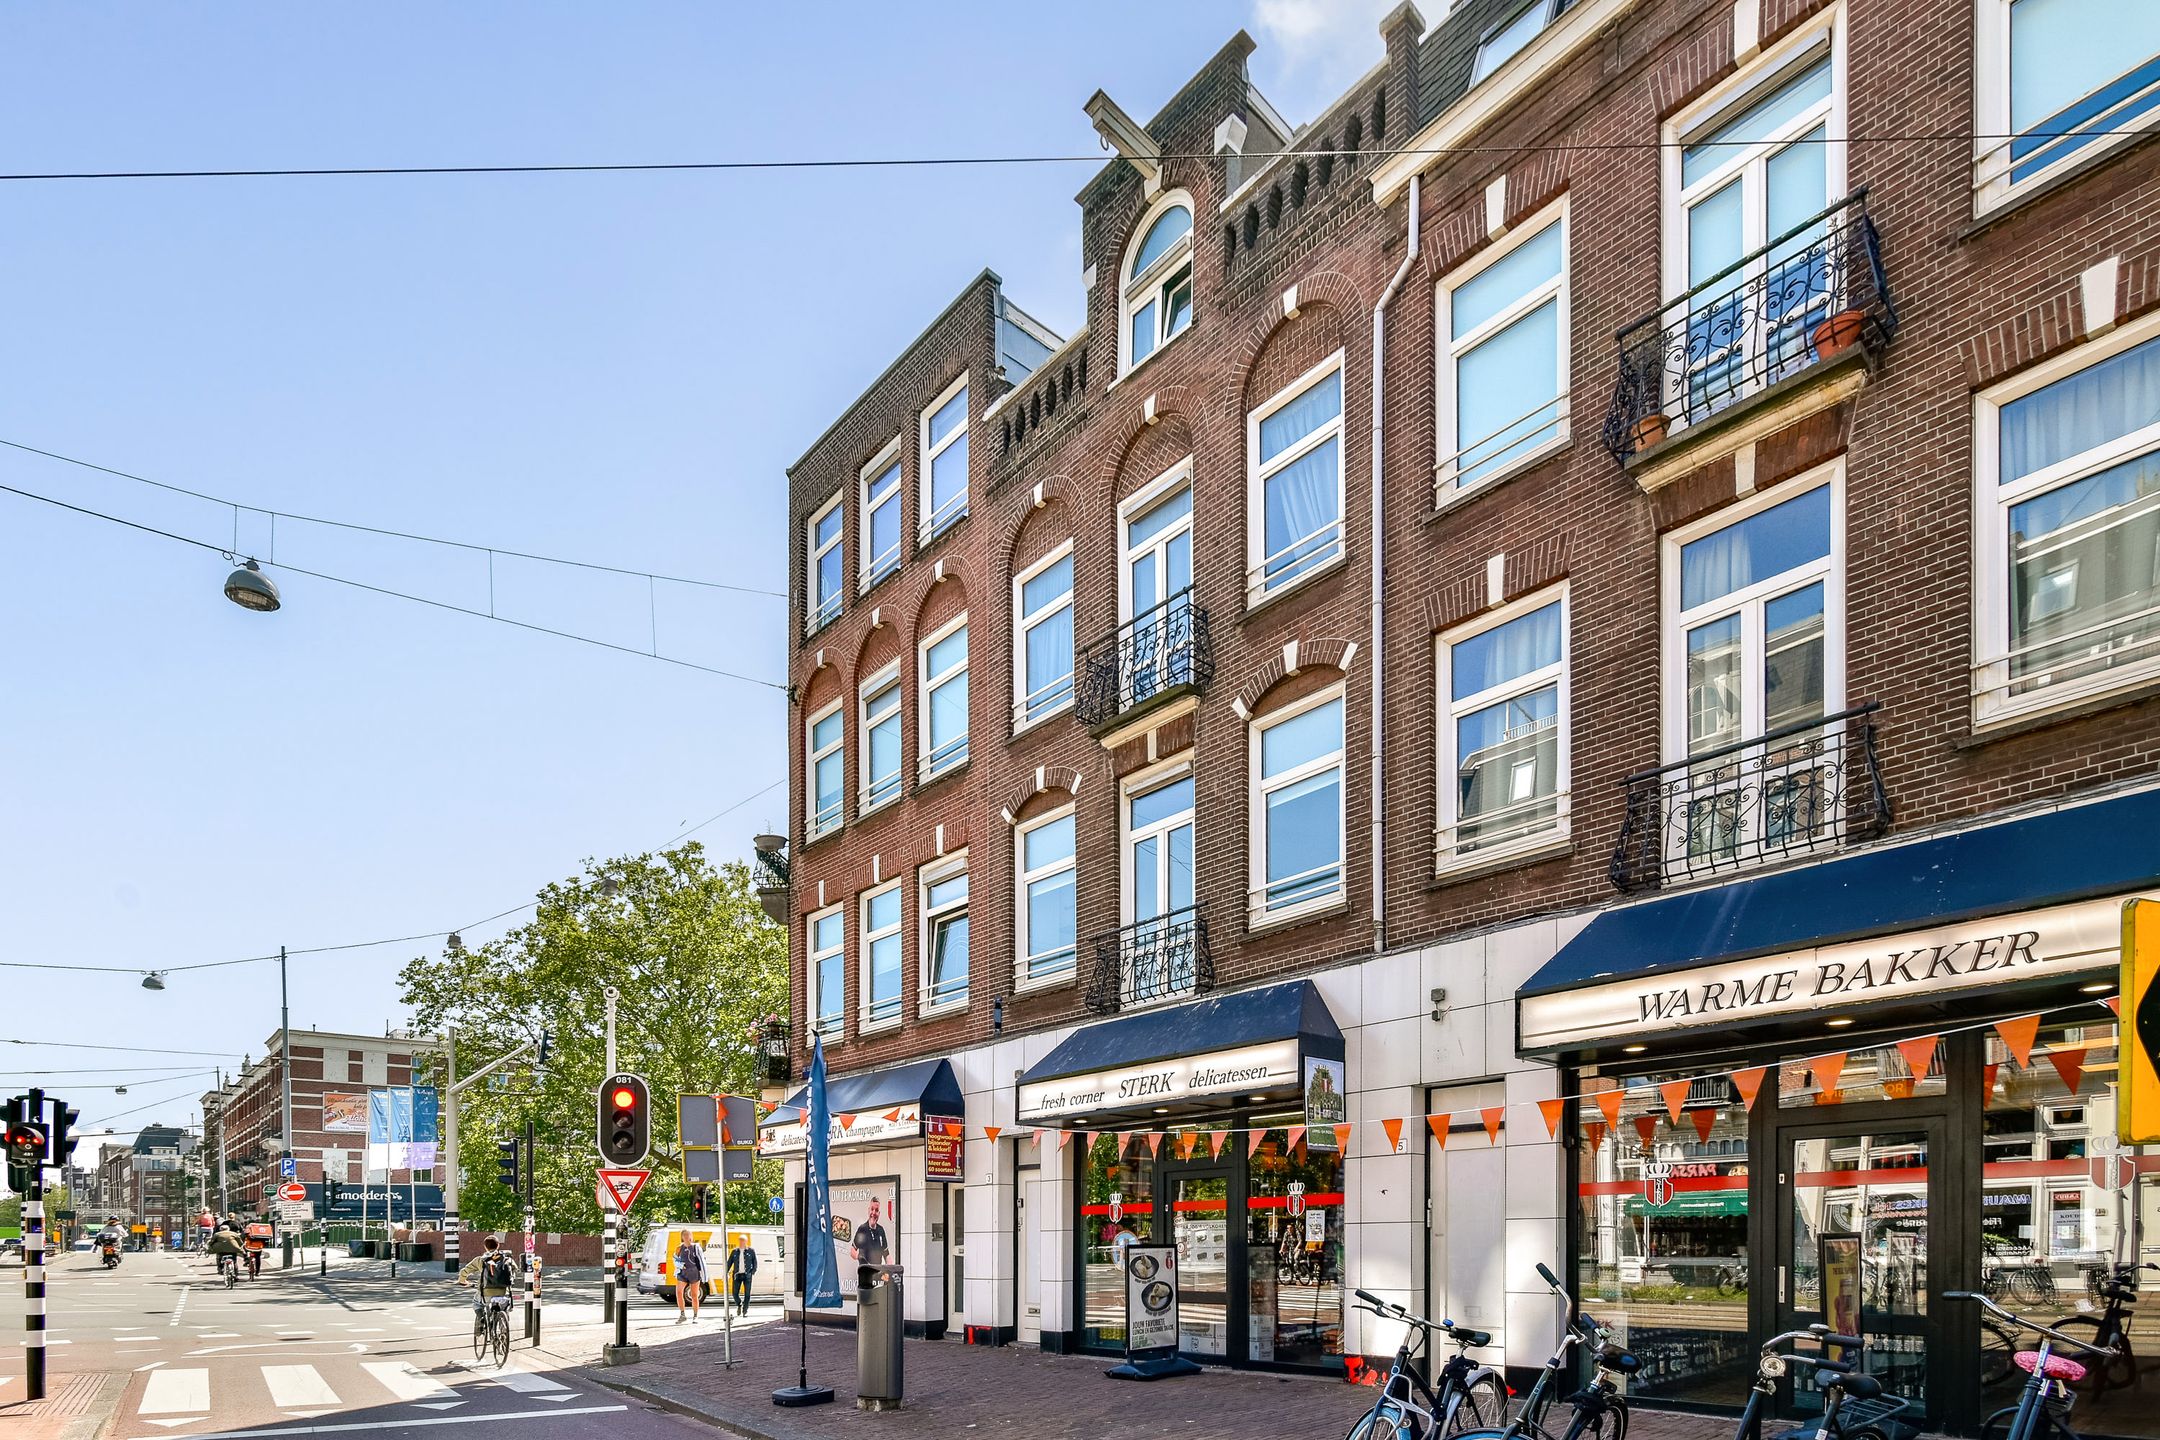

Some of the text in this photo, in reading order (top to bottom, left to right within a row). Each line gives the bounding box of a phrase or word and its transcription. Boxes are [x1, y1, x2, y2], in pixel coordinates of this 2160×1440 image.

[1638, 931, 2041, 1023] WARME BAKKER
[615, 1076, 632, 1084] 081
[1040, 1065, 1268, 1110] fresh corner STERK delicatessen
[846, 1124, 884, 1138] champagne
[1398, 1141, 1404, 1151] 5
